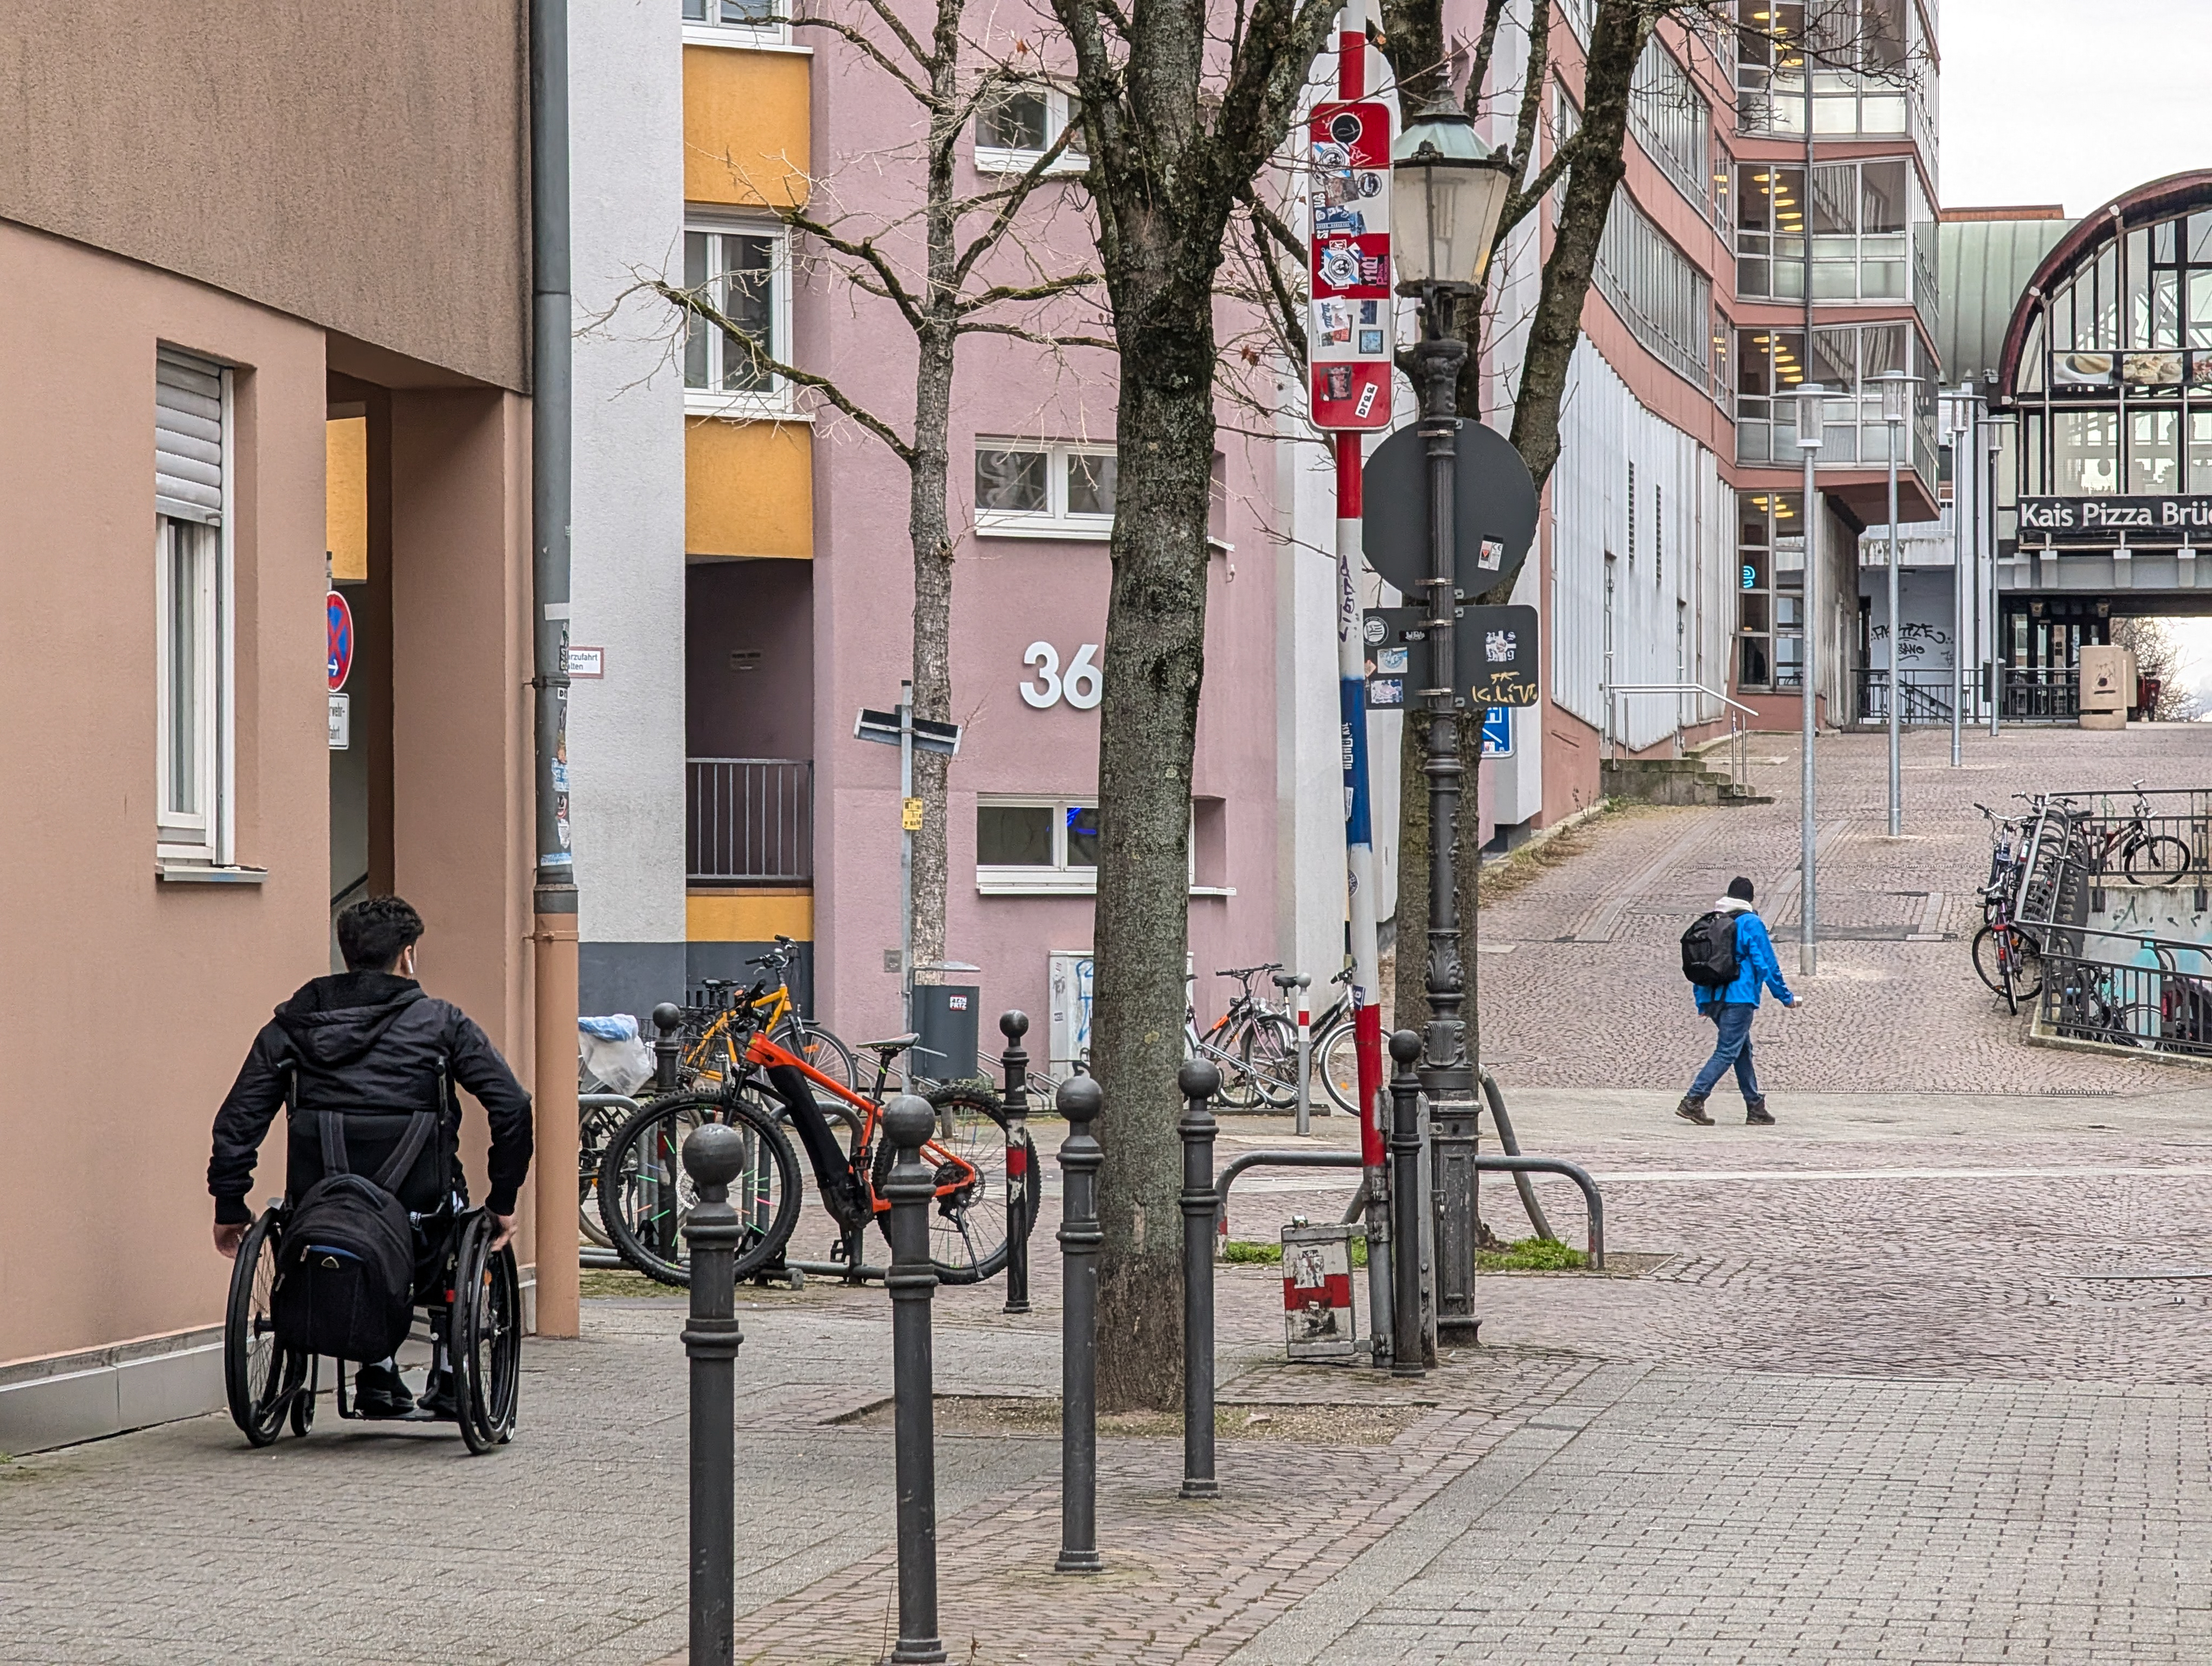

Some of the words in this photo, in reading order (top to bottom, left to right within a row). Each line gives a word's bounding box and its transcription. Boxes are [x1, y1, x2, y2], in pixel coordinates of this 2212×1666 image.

[2021, 502, 2074, 527] Kais
[2082, 502, 2153, 527] Pizza
[2162, 501, 2212, 527] Brü
[1019, 641, 1103, 709] 36
